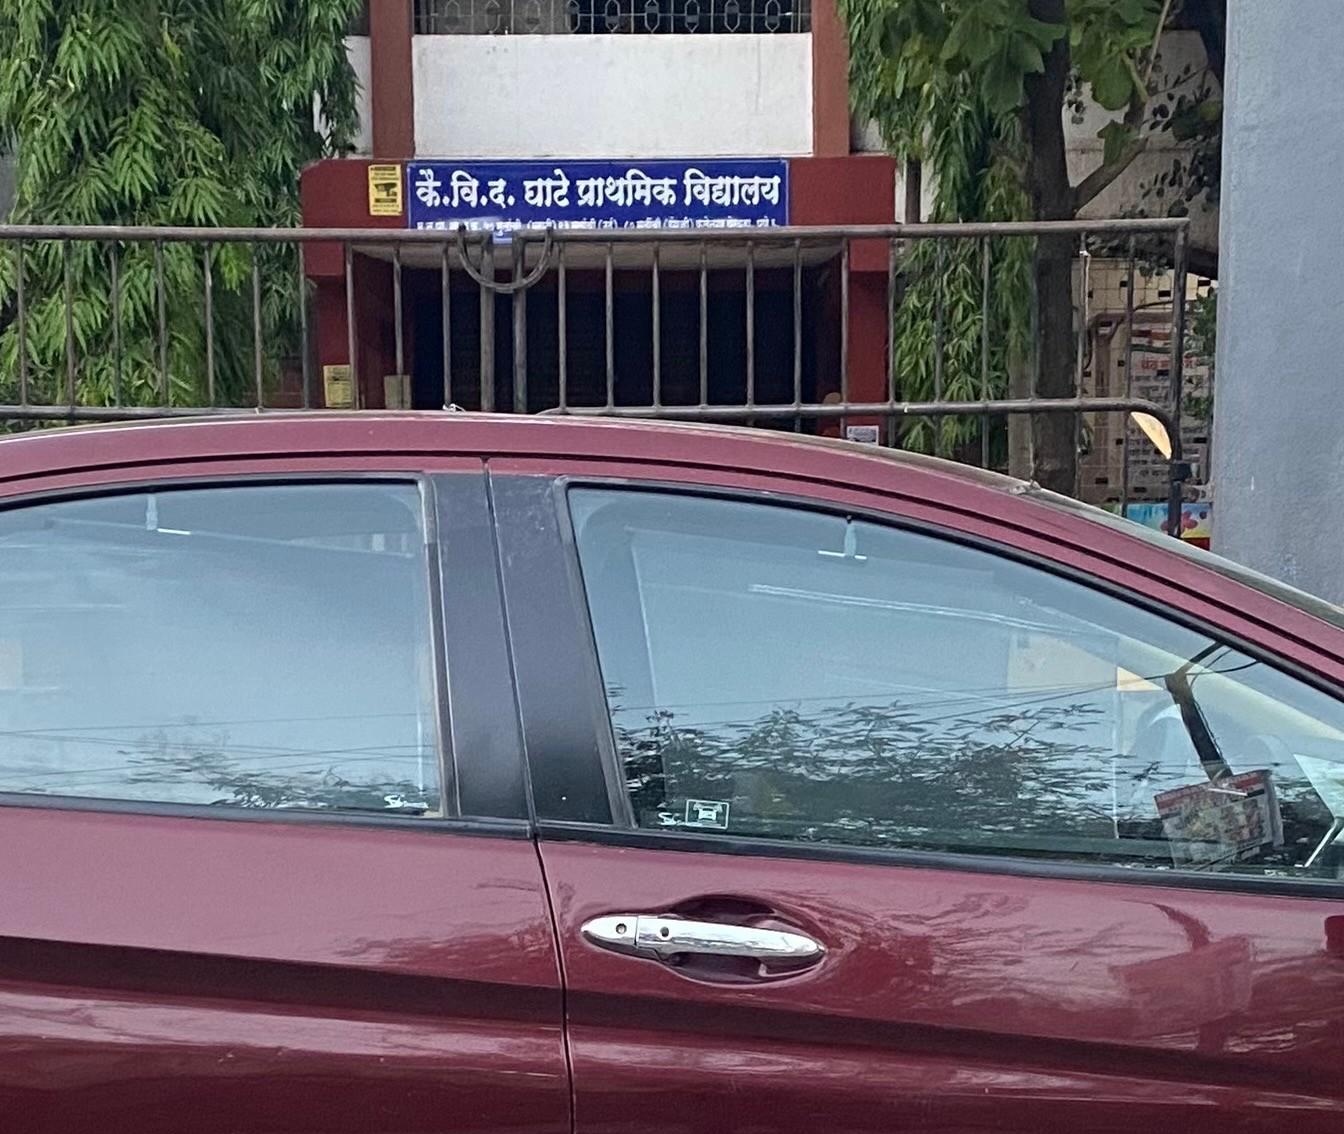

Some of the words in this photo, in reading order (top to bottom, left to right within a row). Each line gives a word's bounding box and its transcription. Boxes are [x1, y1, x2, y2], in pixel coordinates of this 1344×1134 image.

[523, 168, 570, 207] घाटे
[575, 168, 678, 207] प्राथमिक
[682, 168, 781, 207] विद्यालय
